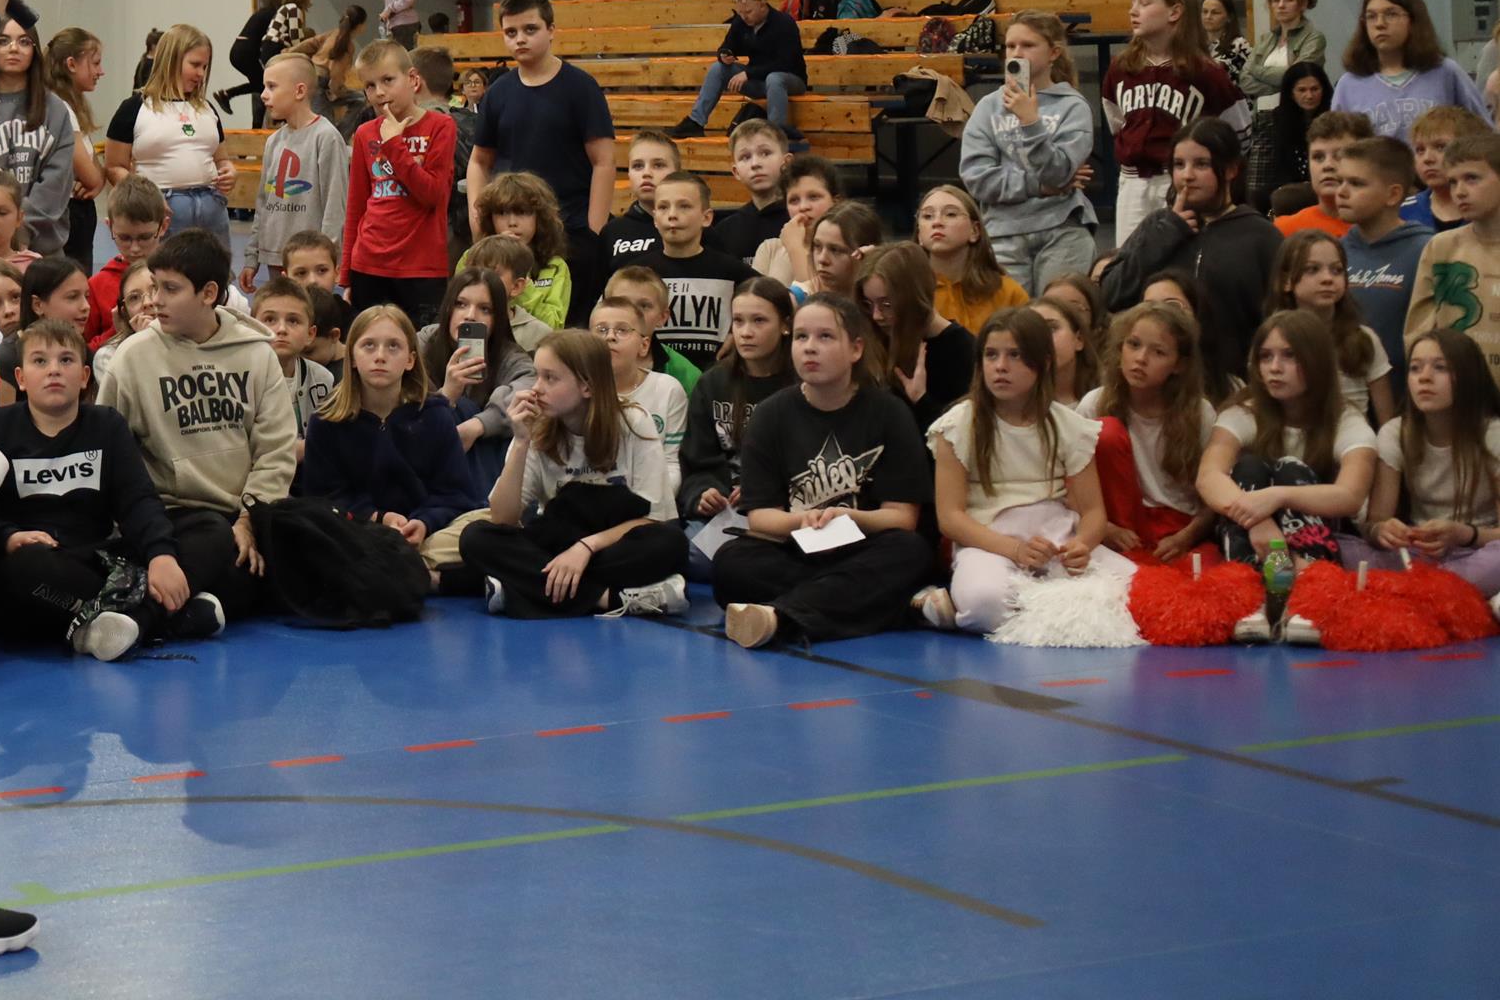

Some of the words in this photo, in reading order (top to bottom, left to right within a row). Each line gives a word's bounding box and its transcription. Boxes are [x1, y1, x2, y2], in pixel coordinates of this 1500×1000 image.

[613, 238, 655, 256] fear
[665, 295, 721, 328] KLYN
[159, 371, 250, 412] ROCKY
[177, 397, 245, 429] BALBOA
